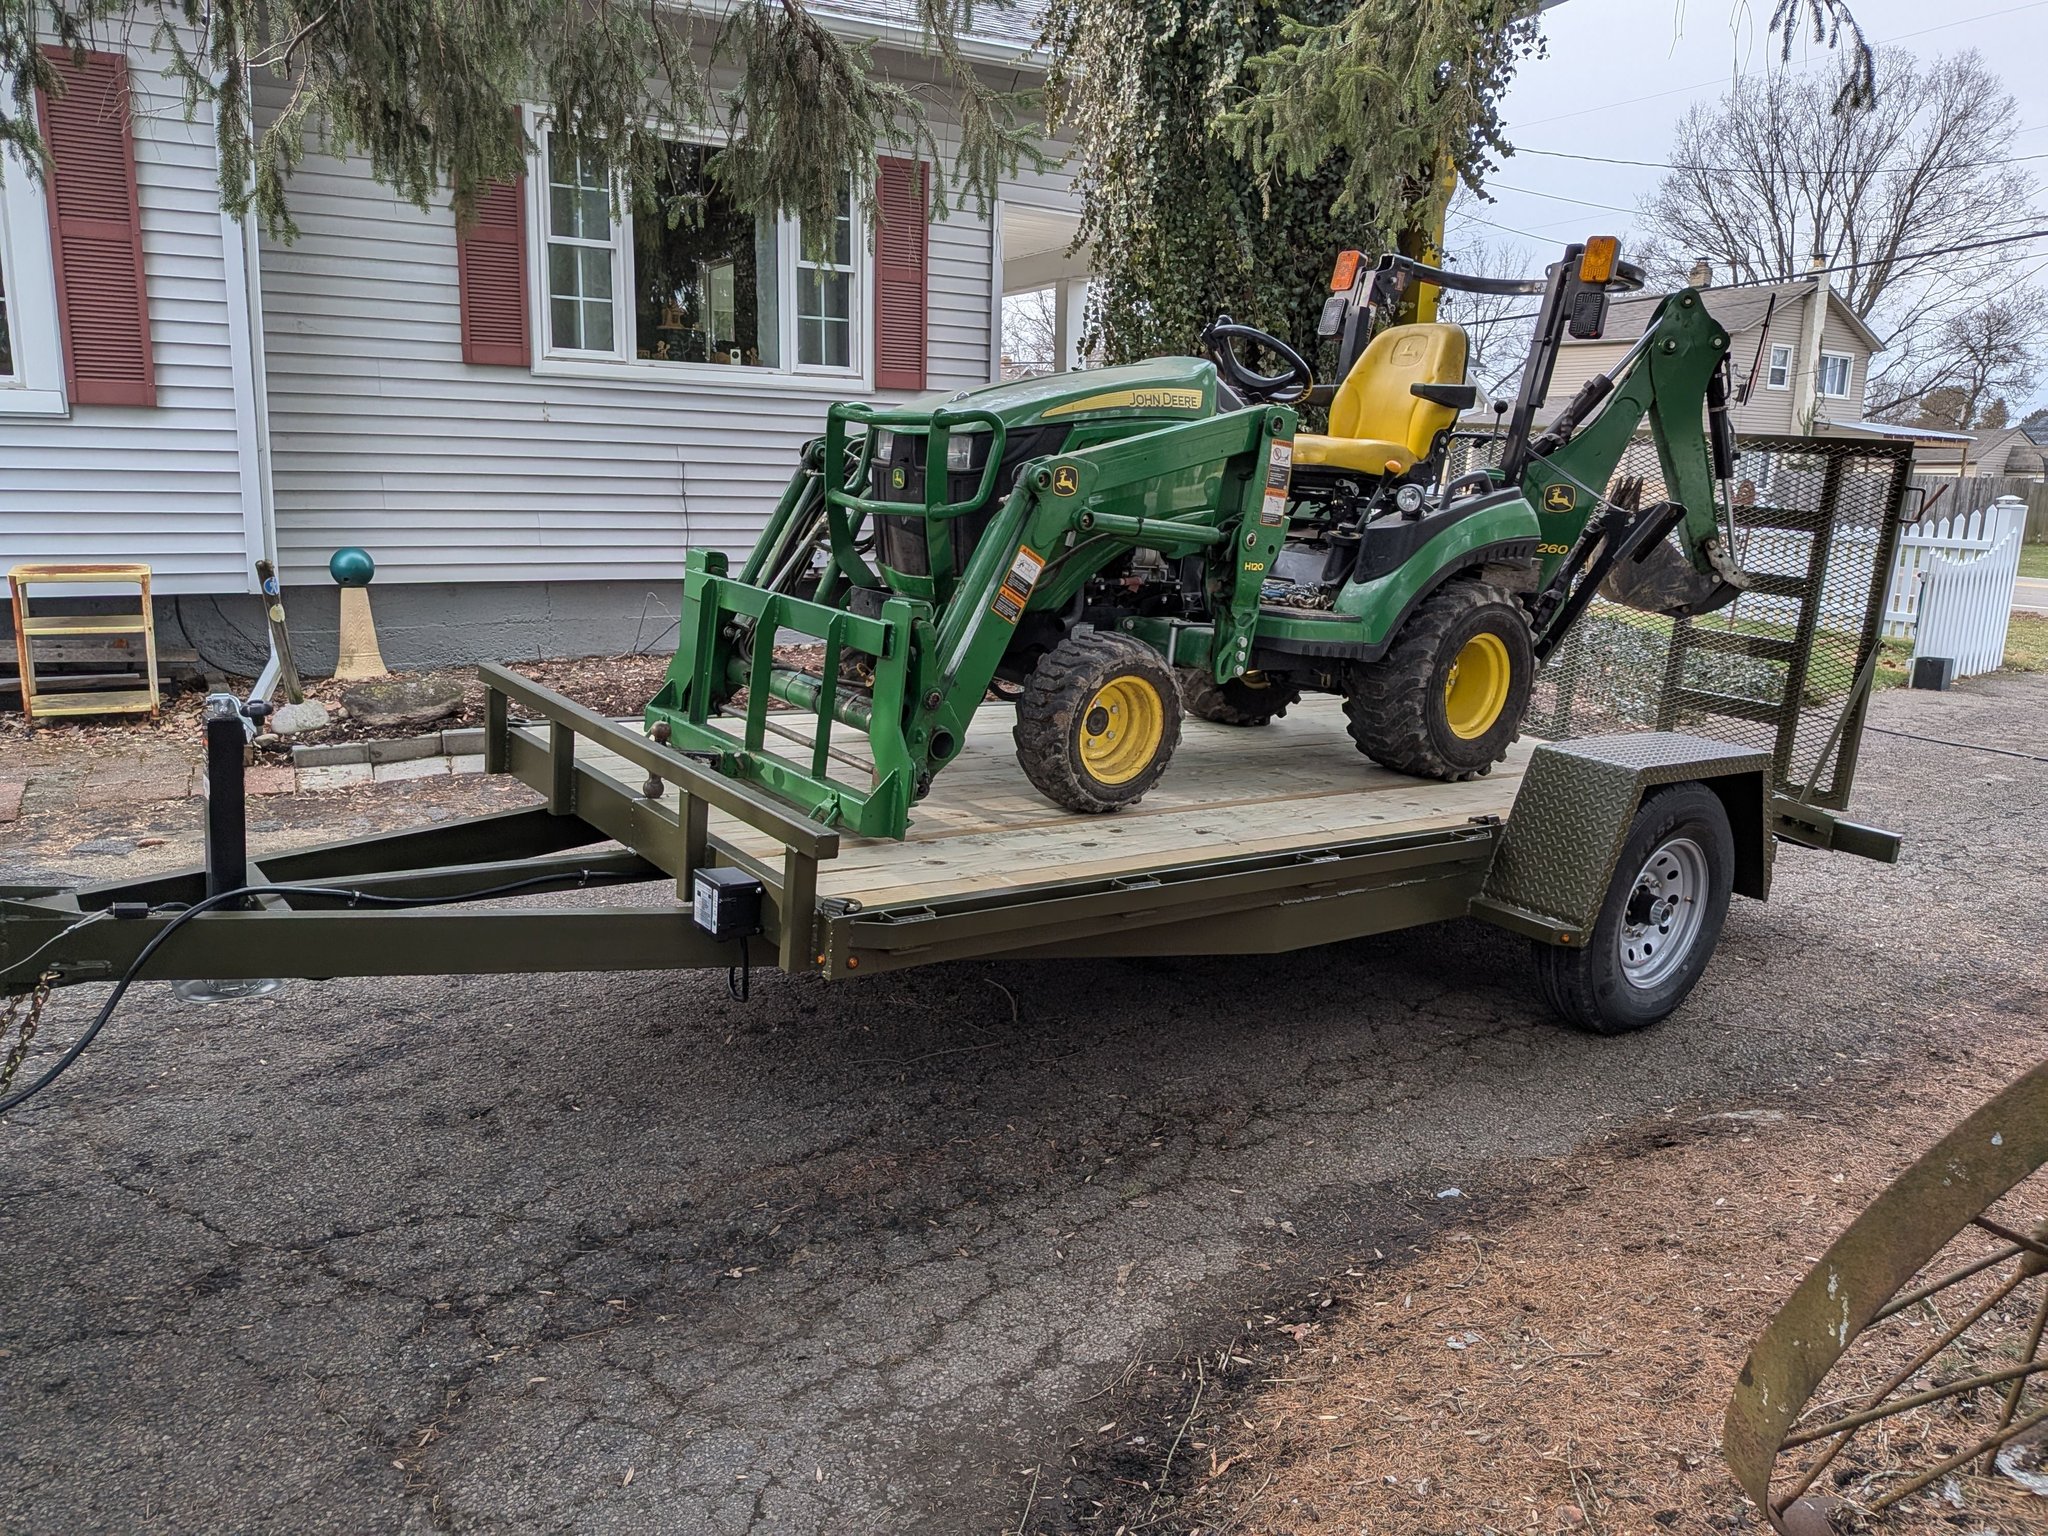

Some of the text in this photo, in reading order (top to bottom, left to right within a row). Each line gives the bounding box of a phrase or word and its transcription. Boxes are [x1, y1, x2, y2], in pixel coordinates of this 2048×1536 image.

[1129, 392, 1198, 408] JOHN DEERE
[1536, 543, 1569, 555] 260
[1244, 562, 1264, 571] H120
